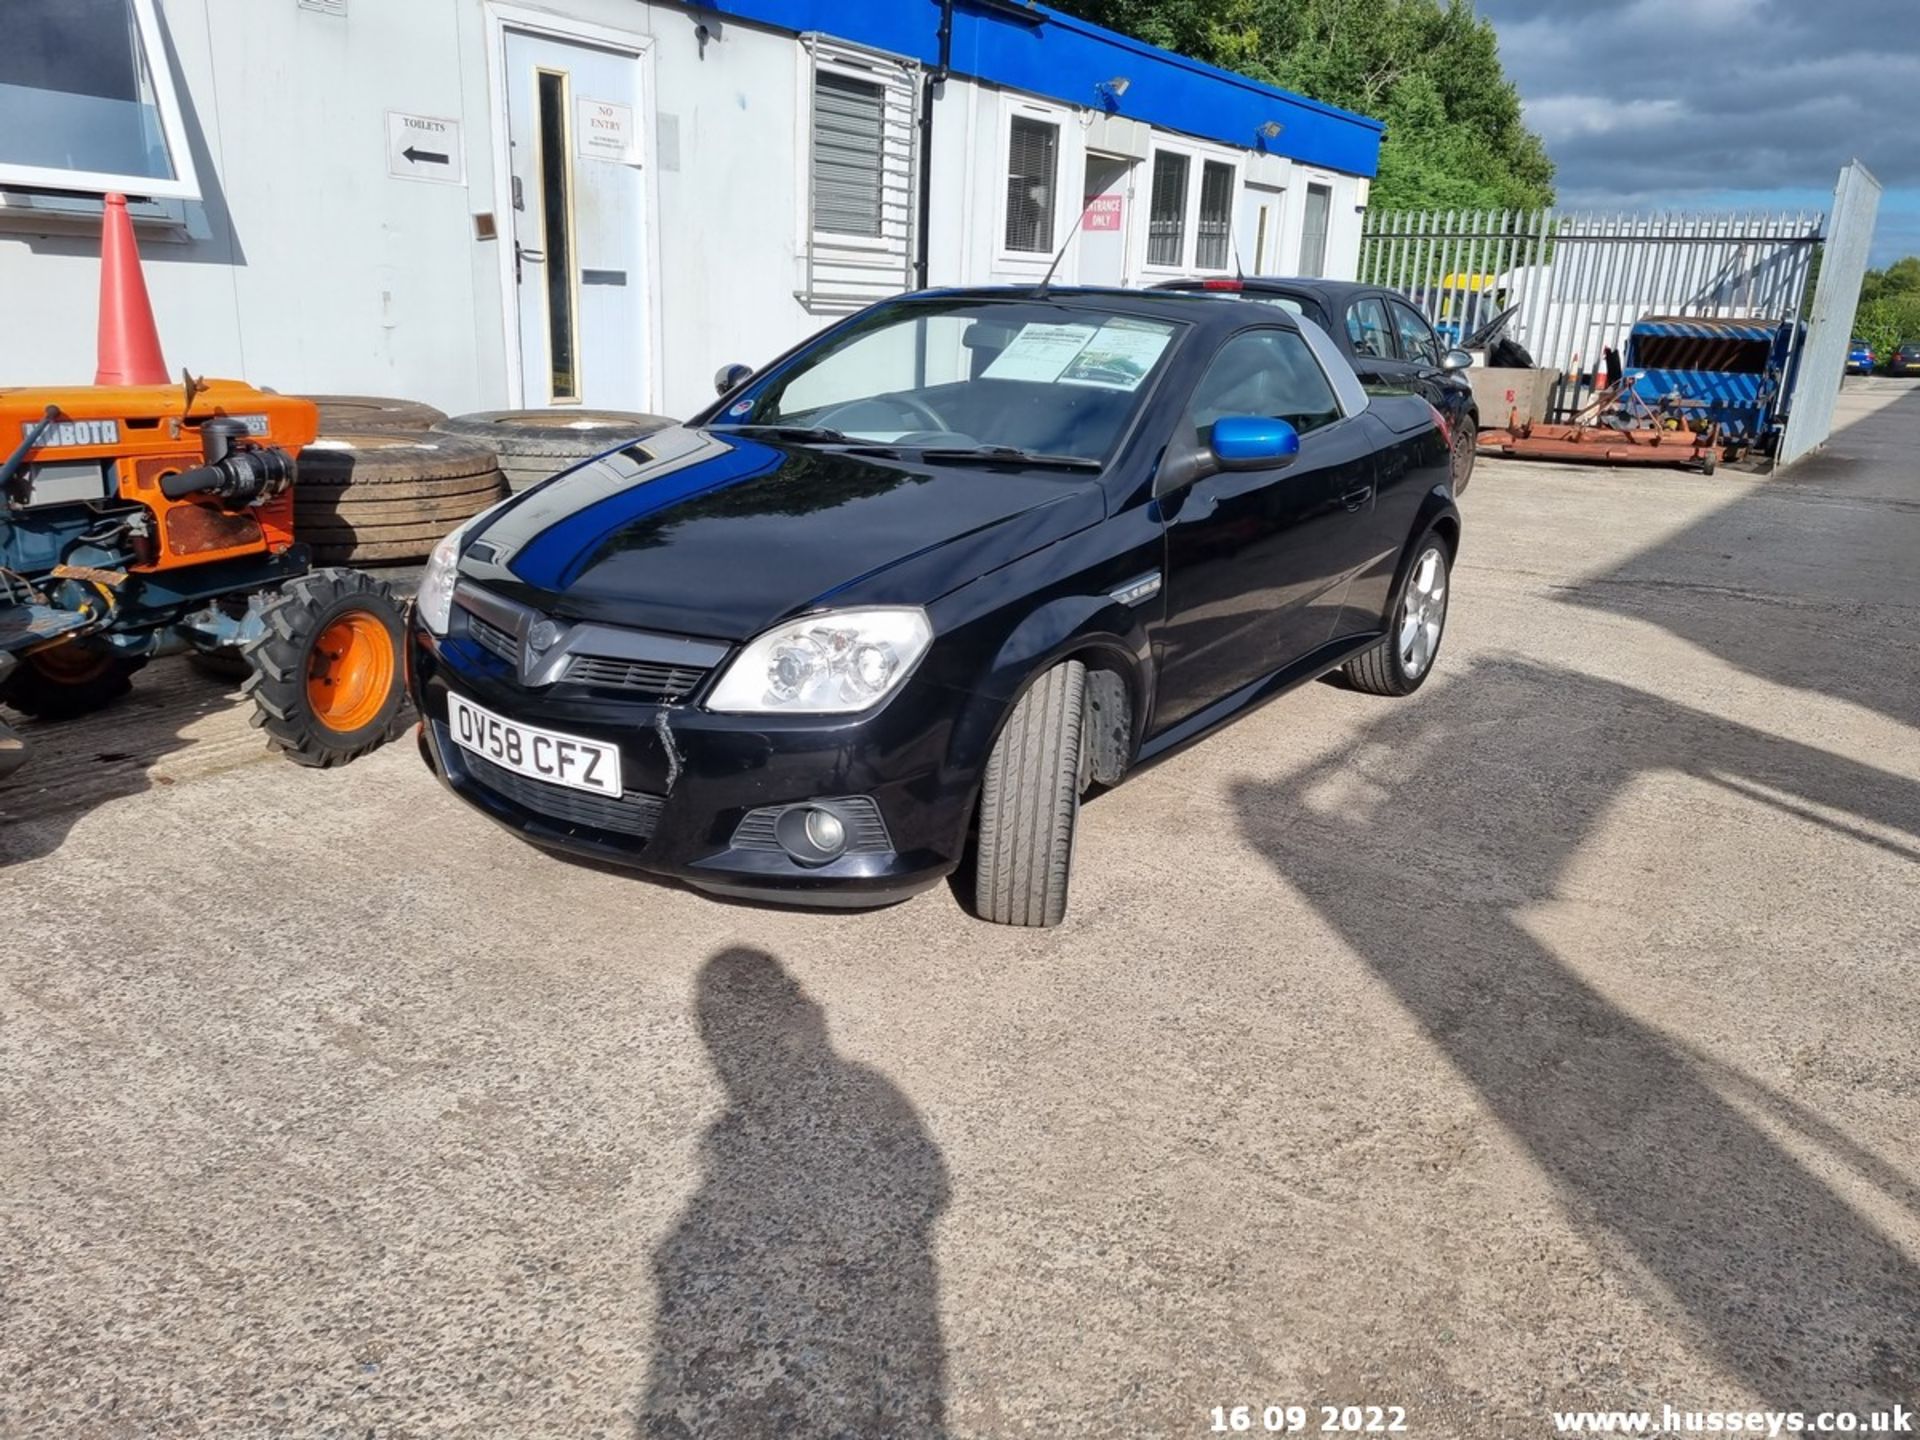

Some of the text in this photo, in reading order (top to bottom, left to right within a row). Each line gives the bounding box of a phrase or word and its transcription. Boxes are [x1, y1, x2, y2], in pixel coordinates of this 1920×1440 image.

[599, 106, 614, 117] NO
[403, 117, 446, 132] TOILETS
[590, 118, 621, 131] ENTRY
[1092, 214, 1111, 227] ONLY
[459, 705, 604, 787] OV58 CFZ
